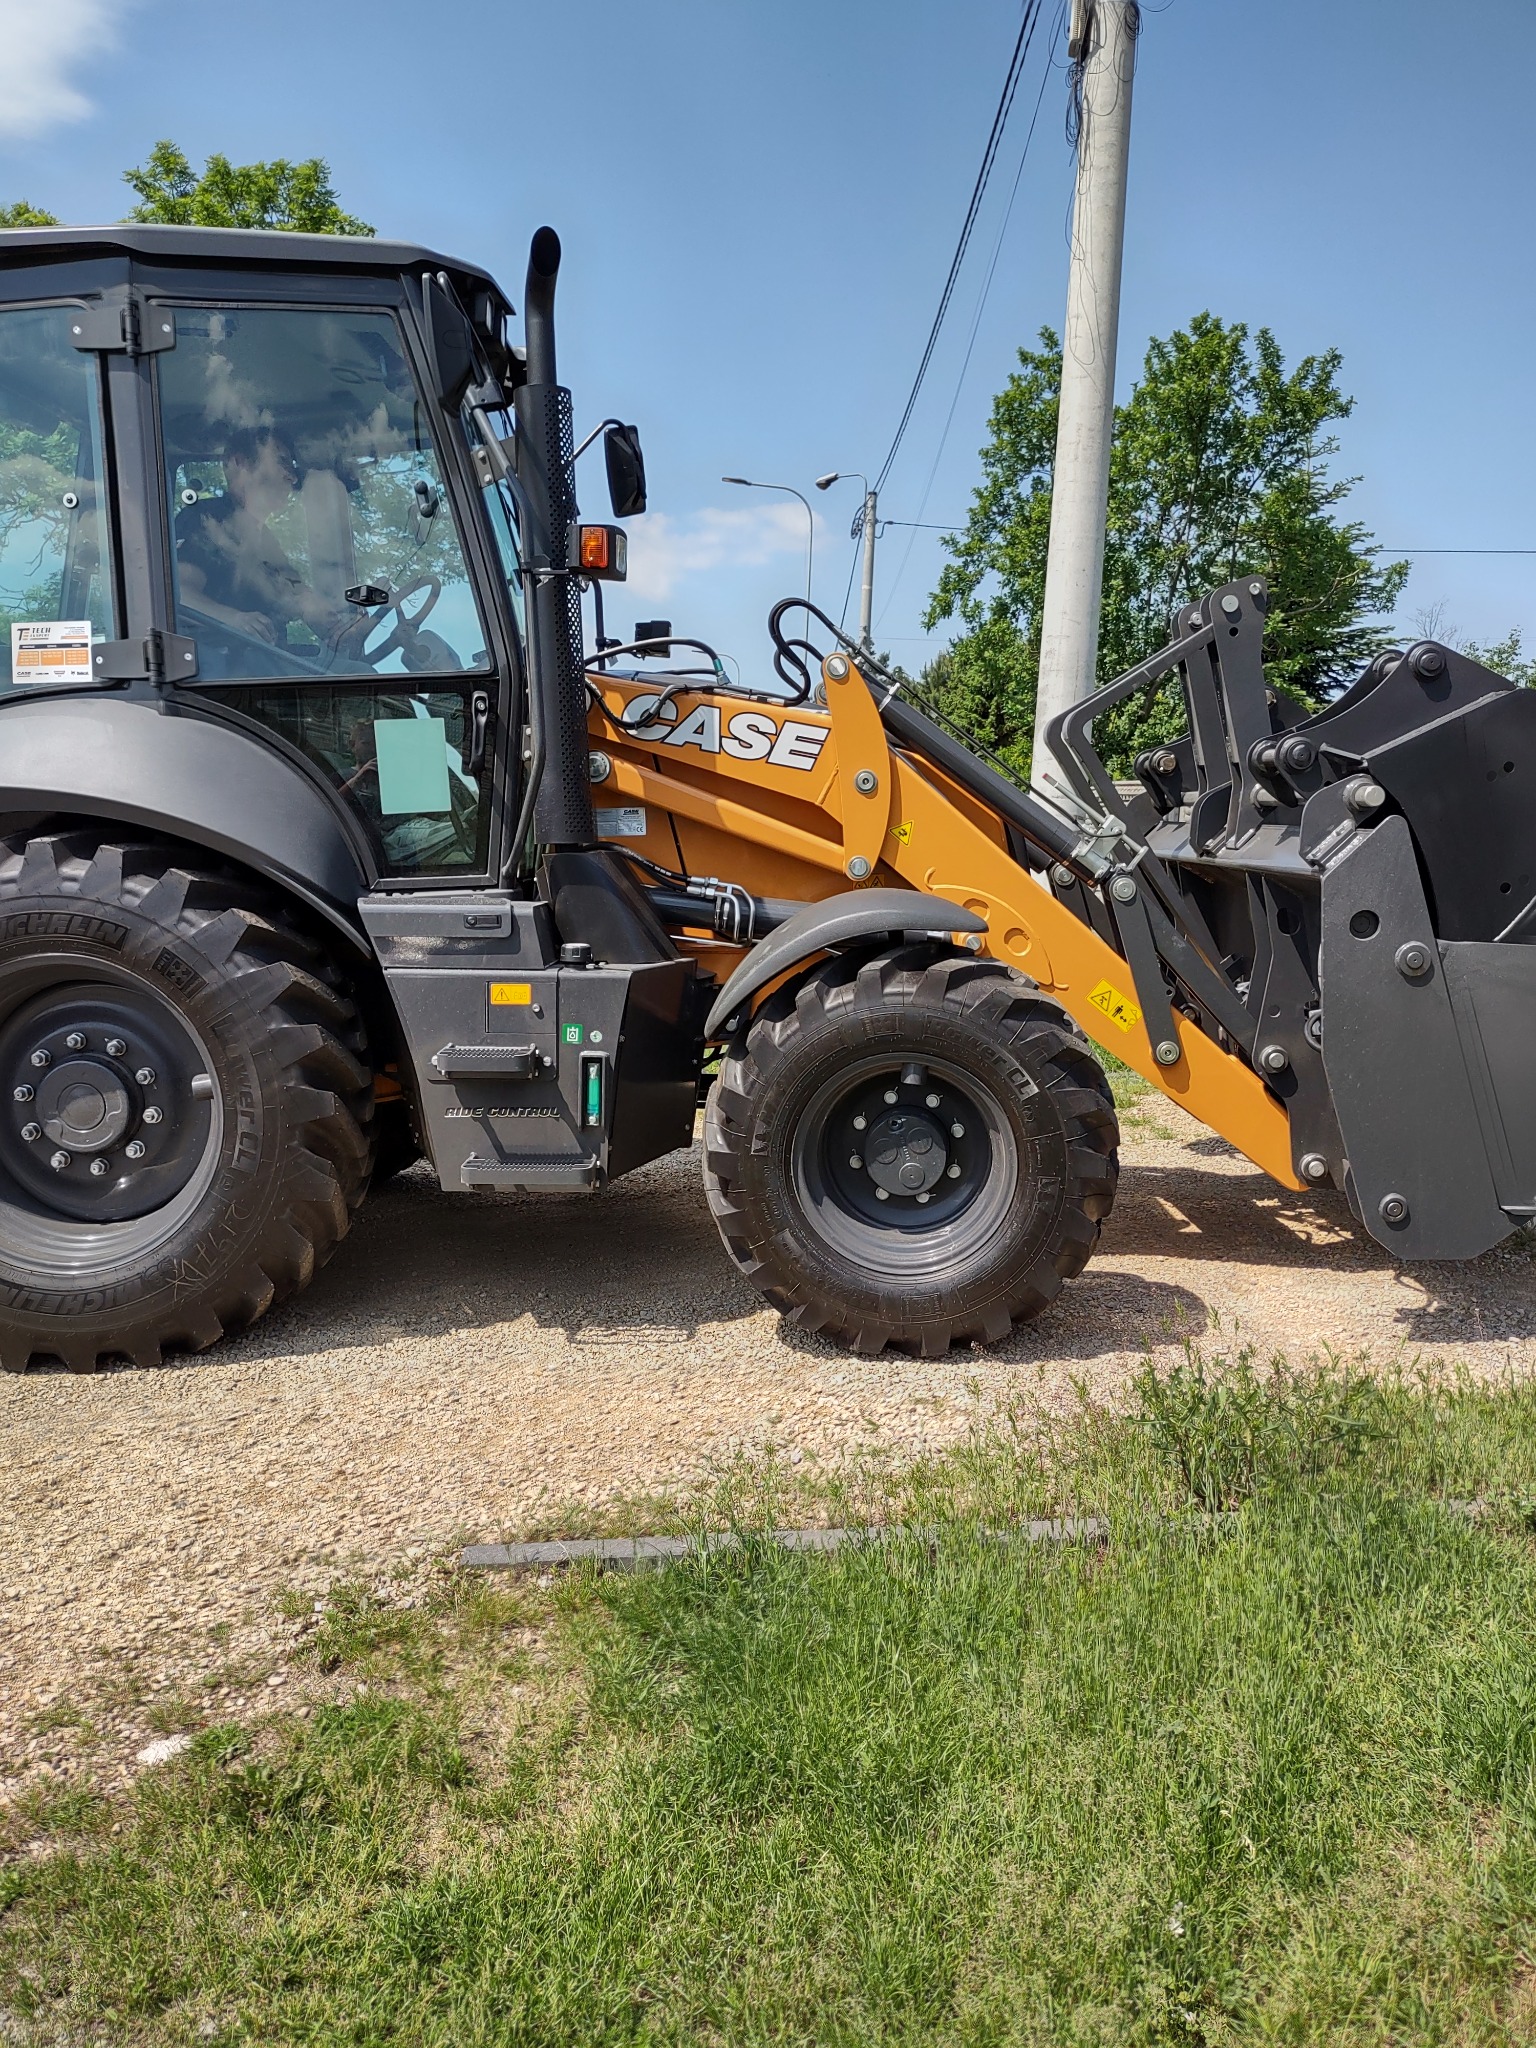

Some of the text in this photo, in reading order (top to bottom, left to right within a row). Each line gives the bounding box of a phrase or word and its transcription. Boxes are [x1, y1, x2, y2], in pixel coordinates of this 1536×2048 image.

[621, 693, 832, 772] CASE
[0, 913, 126, 944] ICHELIN
[444, 1106, 561, 1118] RIDE CONTROL
